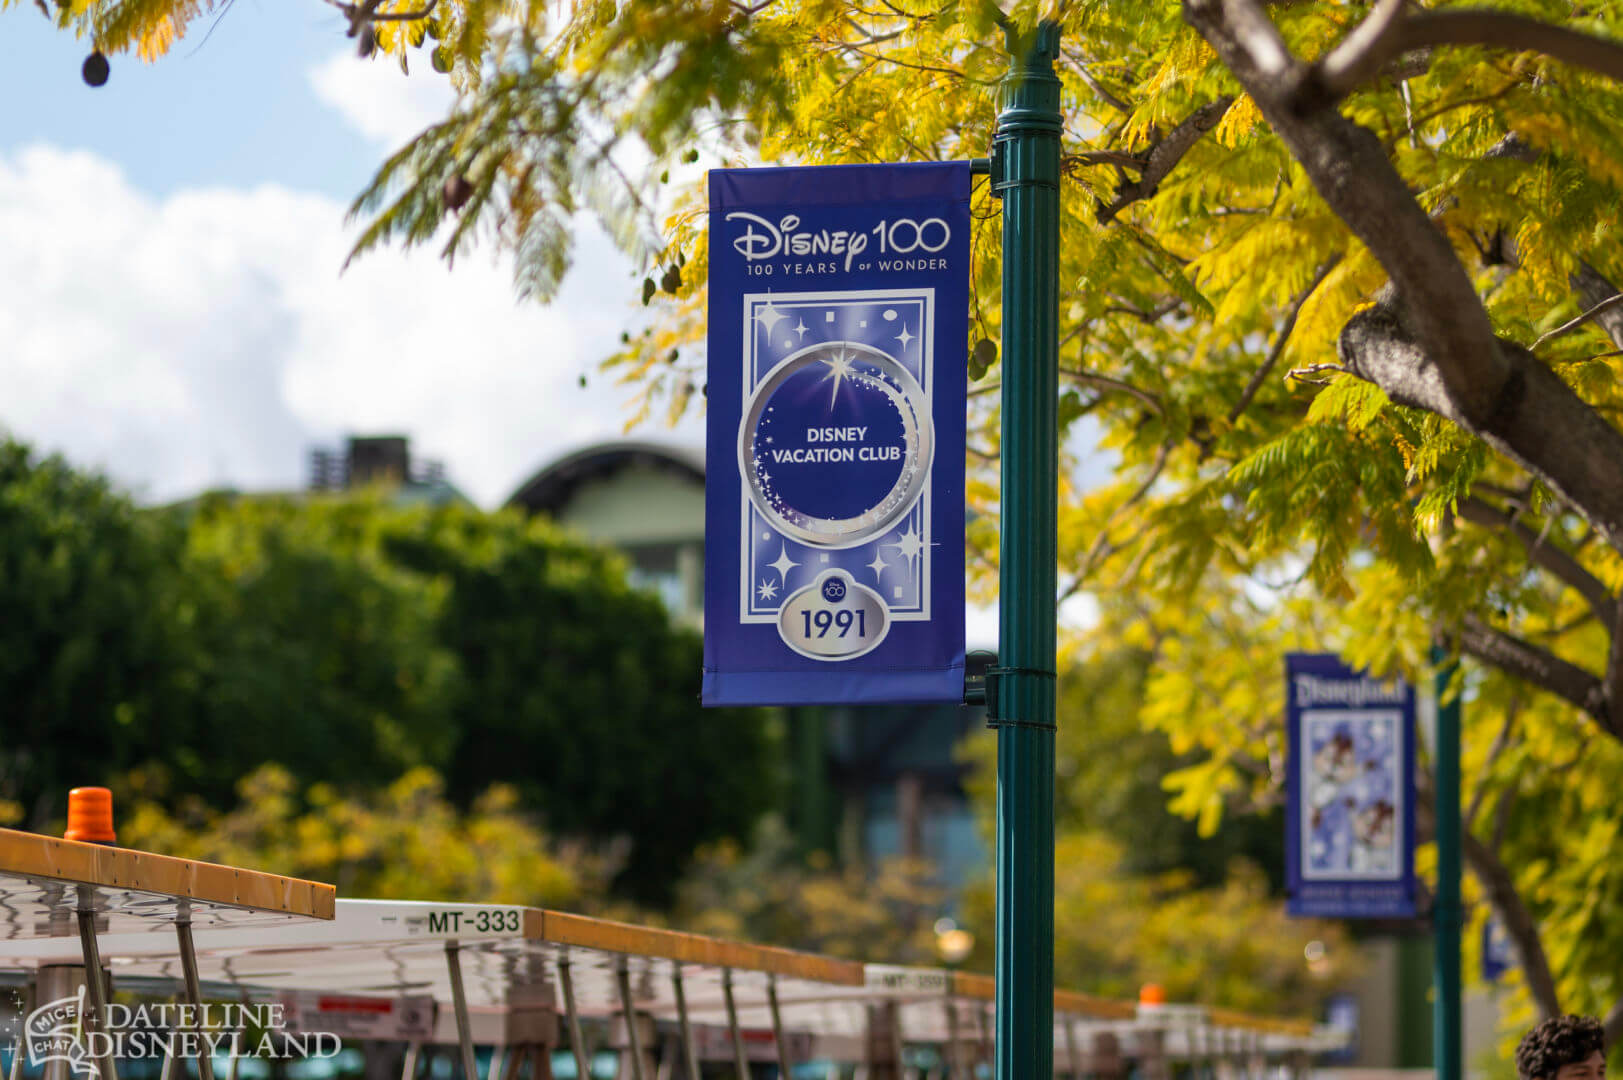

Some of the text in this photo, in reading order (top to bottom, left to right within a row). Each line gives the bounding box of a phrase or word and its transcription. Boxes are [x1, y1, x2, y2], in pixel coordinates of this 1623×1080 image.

[872, 217, 951, 254] 100
[747, 264, 773, 275] 100
[783, 262, 837, 275] YEARS
[878, 259, 948, 272] WONDER
[807, 427, 868, 443] DISNEY
[772, 446, 901, 463] VACATION CLUB
[800, 609, 866, 639] 1991
[428, 910, 519, 933] MT-333
